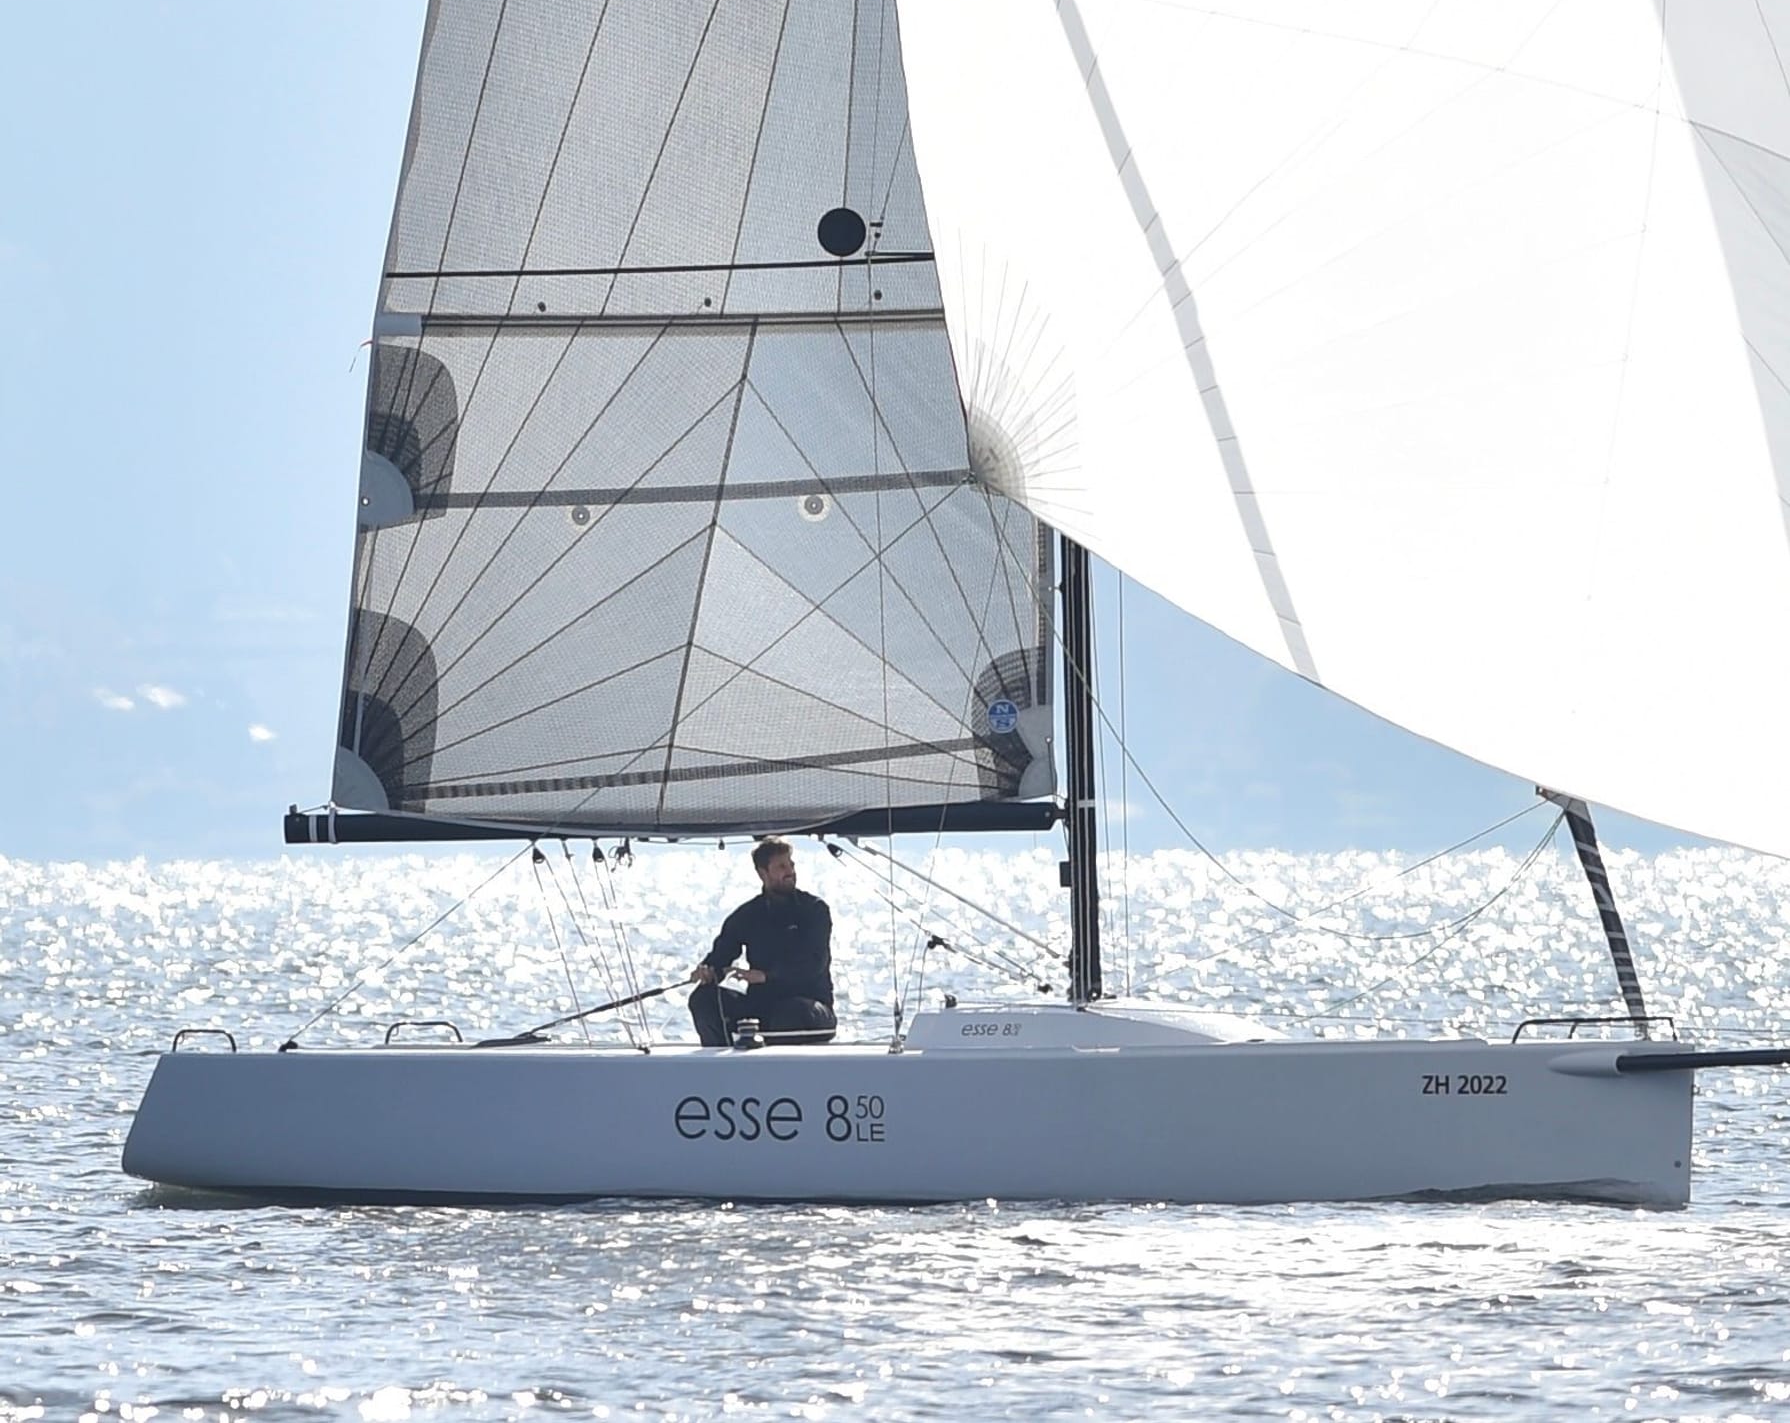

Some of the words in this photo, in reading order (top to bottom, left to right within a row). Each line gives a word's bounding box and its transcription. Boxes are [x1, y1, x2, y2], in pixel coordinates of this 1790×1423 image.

[961, 1023, 999, 1036] esse
[1422, 1075, 1450, 1095] ZH
[1457, 1075, 1508, 1095] 2022
[674, 1096, 803, 1141] esse
[856, 1123, 886, 1142] LE
